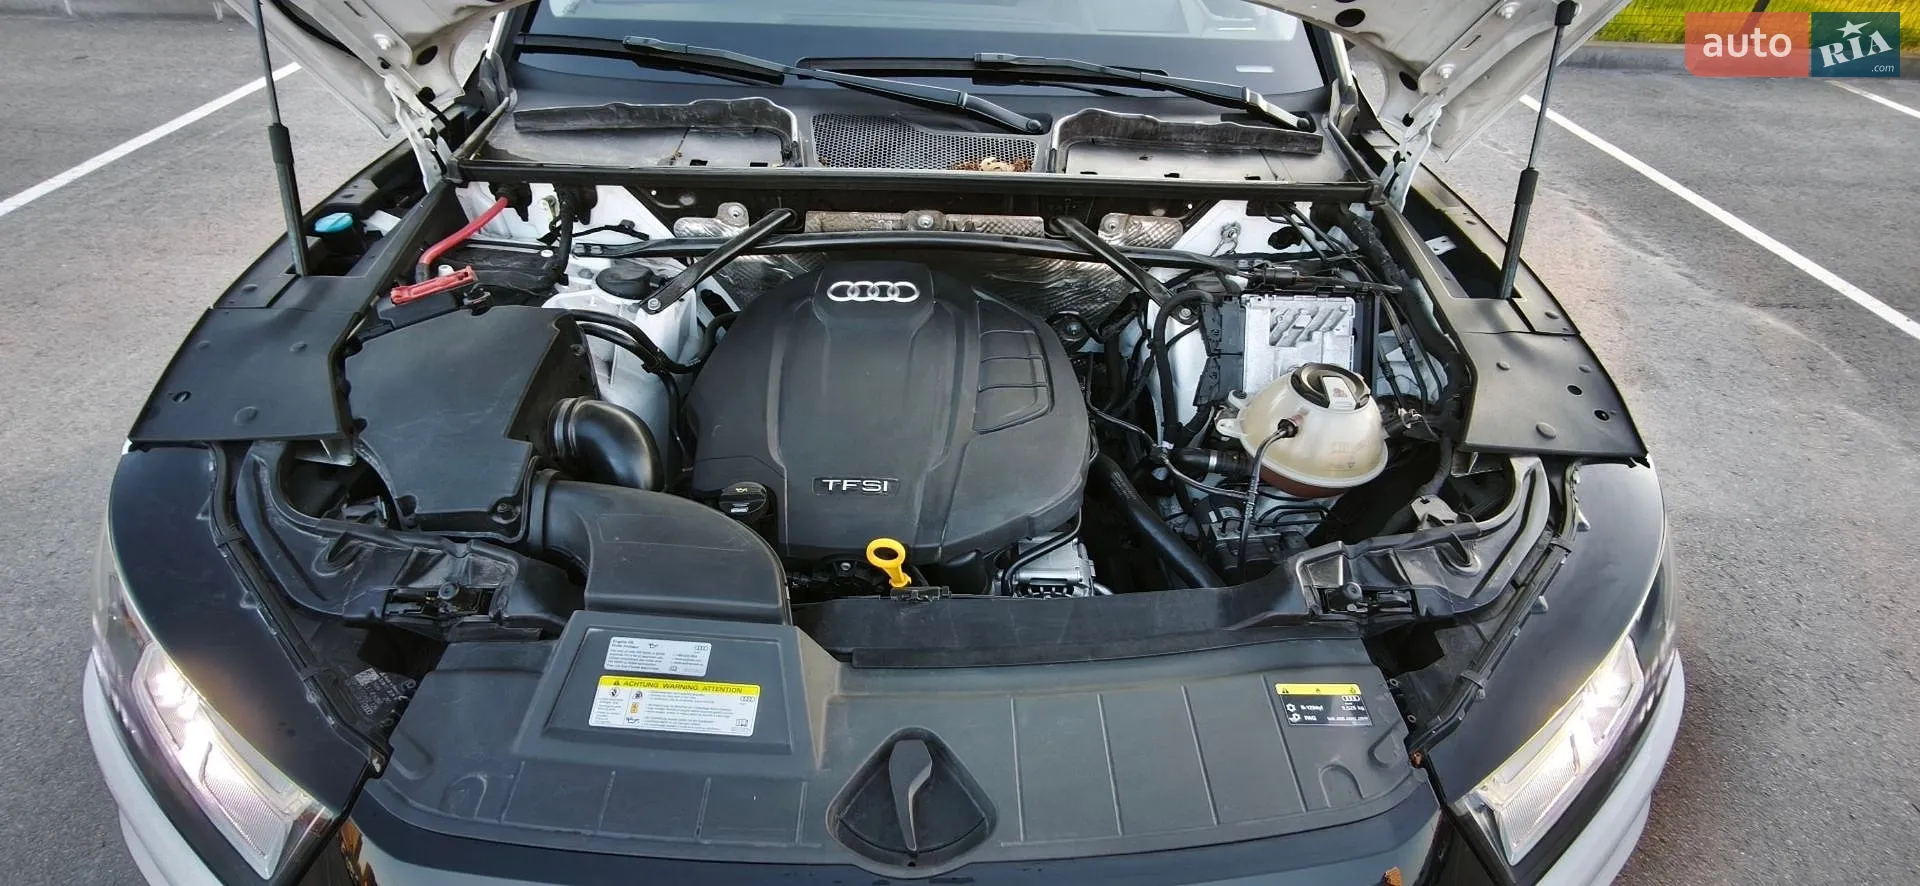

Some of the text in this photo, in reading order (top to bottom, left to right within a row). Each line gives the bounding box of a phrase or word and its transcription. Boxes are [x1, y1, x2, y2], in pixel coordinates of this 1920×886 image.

[821, 479, 889, 492] TFSI
[623, 681, 743, 694] ACHTUNG WARNING ATTENTION
